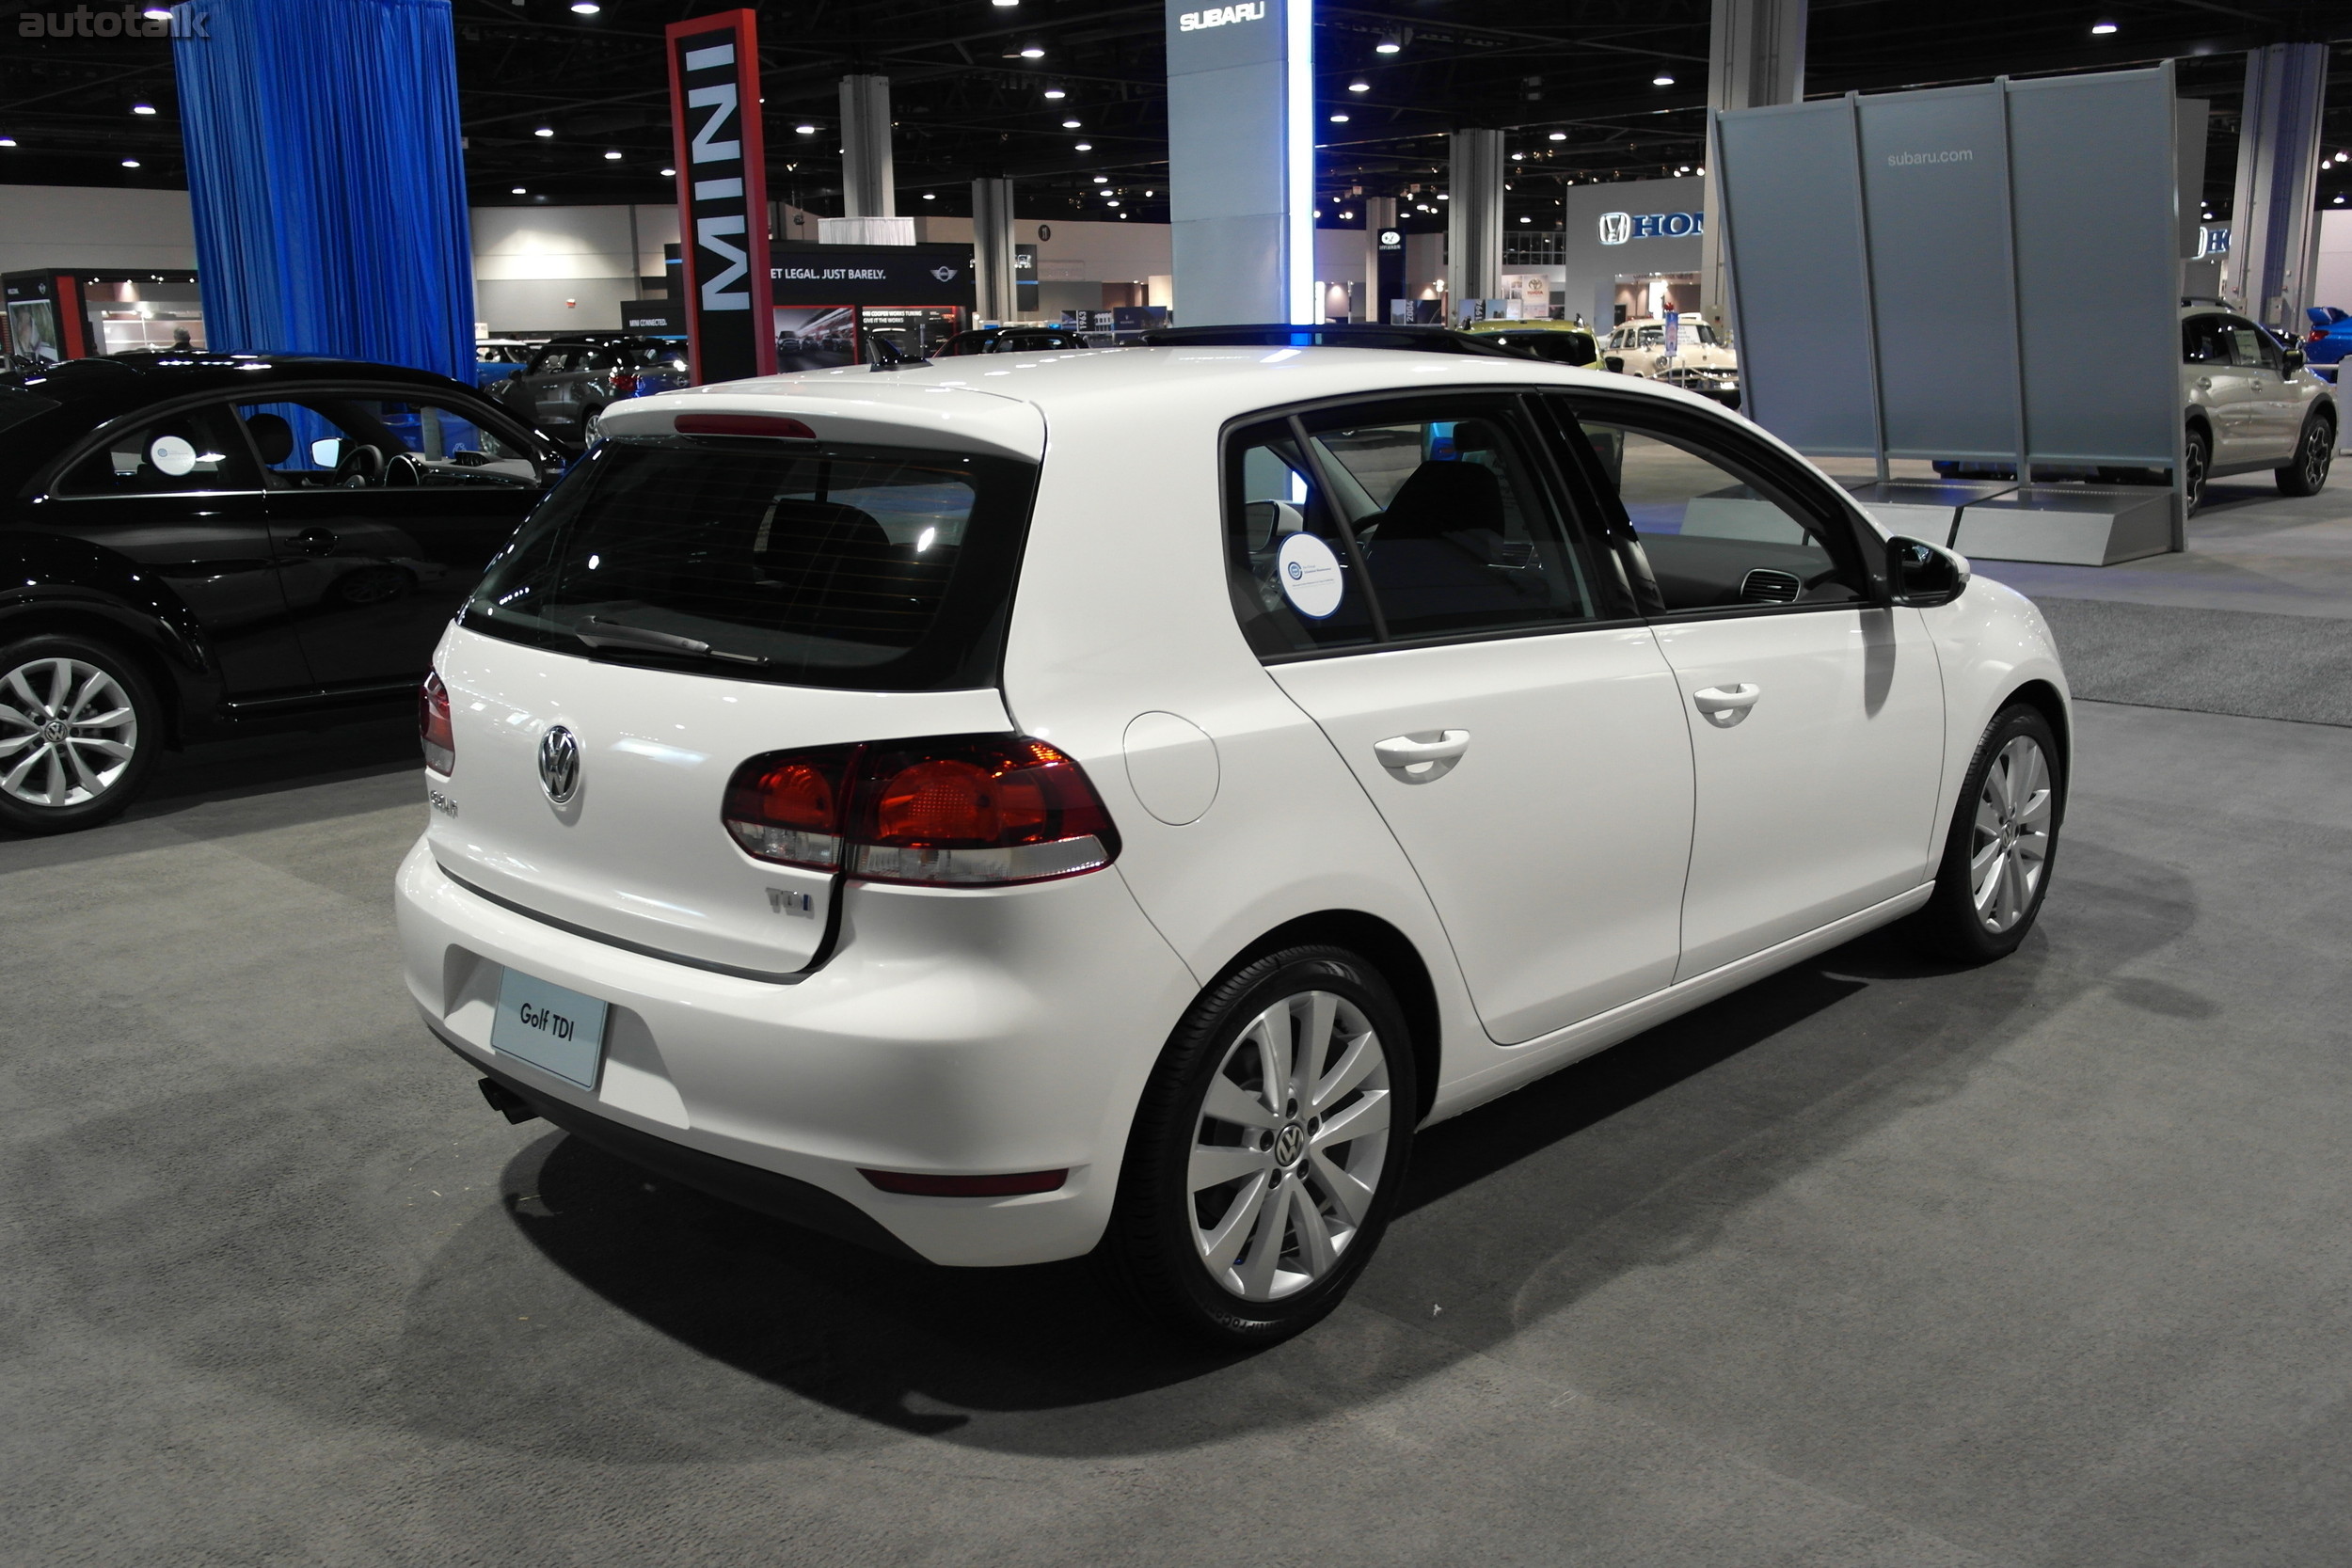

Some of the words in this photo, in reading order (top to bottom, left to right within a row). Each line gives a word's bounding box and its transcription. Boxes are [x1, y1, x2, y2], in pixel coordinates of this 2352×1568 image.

[1180, 1, 1265, 32] SUBARU
[1887, 150, 1973, 166] subaru.com
[685, 43, 750, 311] MINI
[785, 268, 820, 279] LEGAL.
[821, 268, 846, 279] JUST
[848, 269, 886, 280] BARELY.
[520, 1003, 549, 1031] Golf
[552, 1013, 574, 1042] TDI
